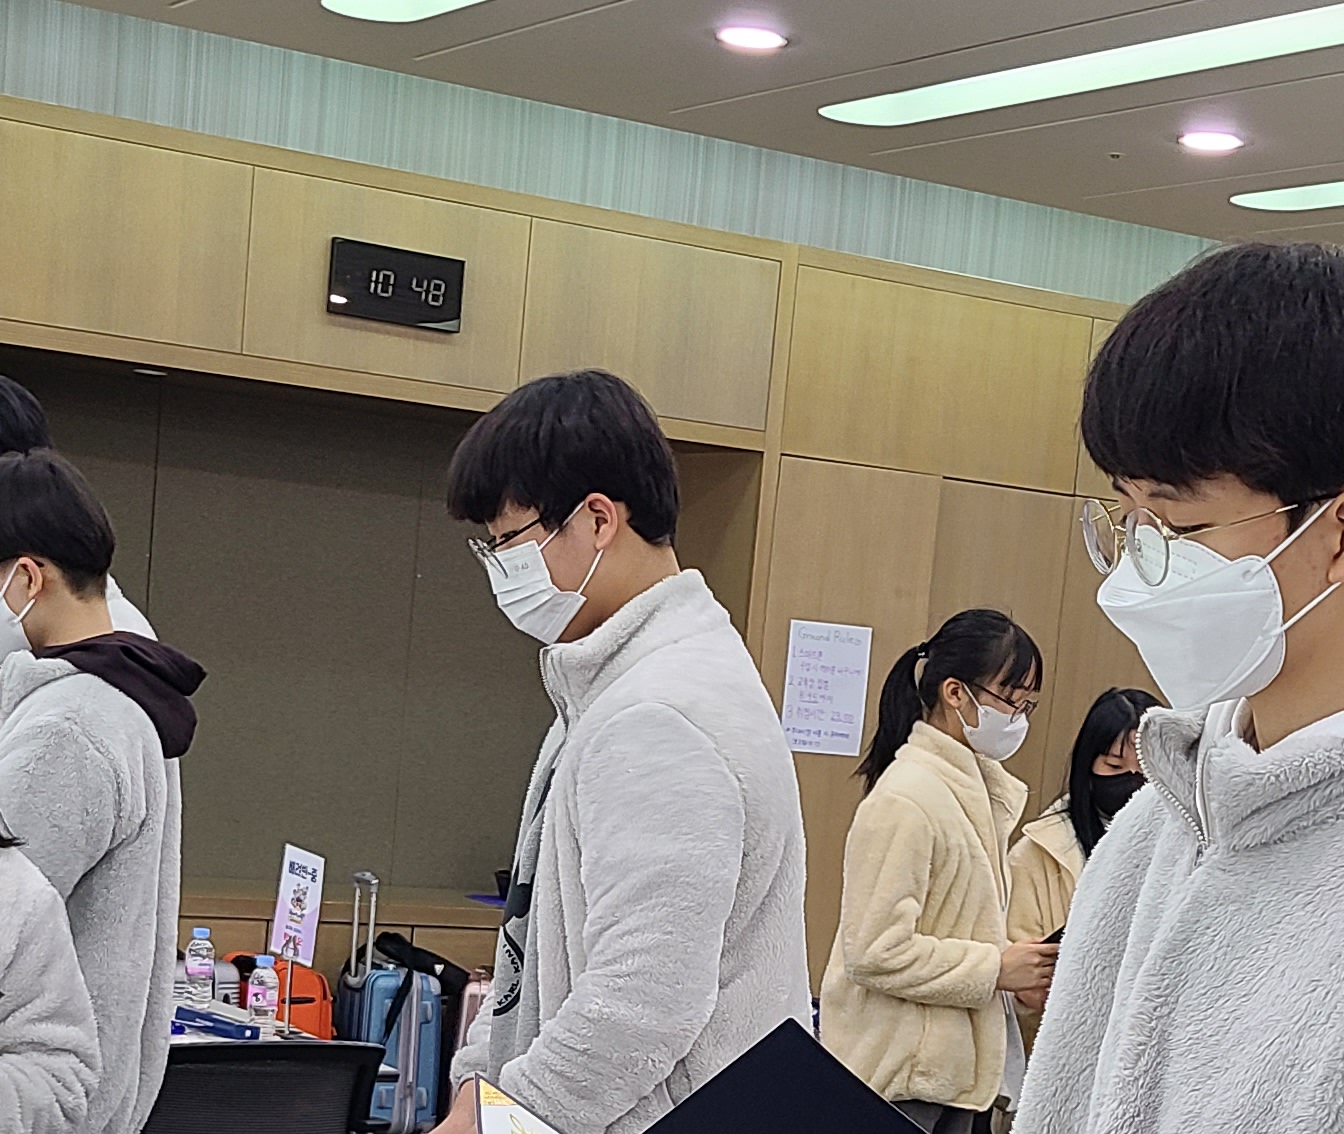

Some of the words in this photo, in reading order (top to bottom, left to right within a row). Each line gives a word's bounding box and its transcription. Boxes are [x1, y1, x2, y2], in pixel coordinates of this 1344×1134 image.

[368, 269, 395, 298] 10
[411, 276, 446, 307] 48
[797, 626, 831, 642] Ground
[833, 630, 862, 646] Rules
[502, 943, 521, 974] KANI
[496, 979, 520, 1007] KARL
